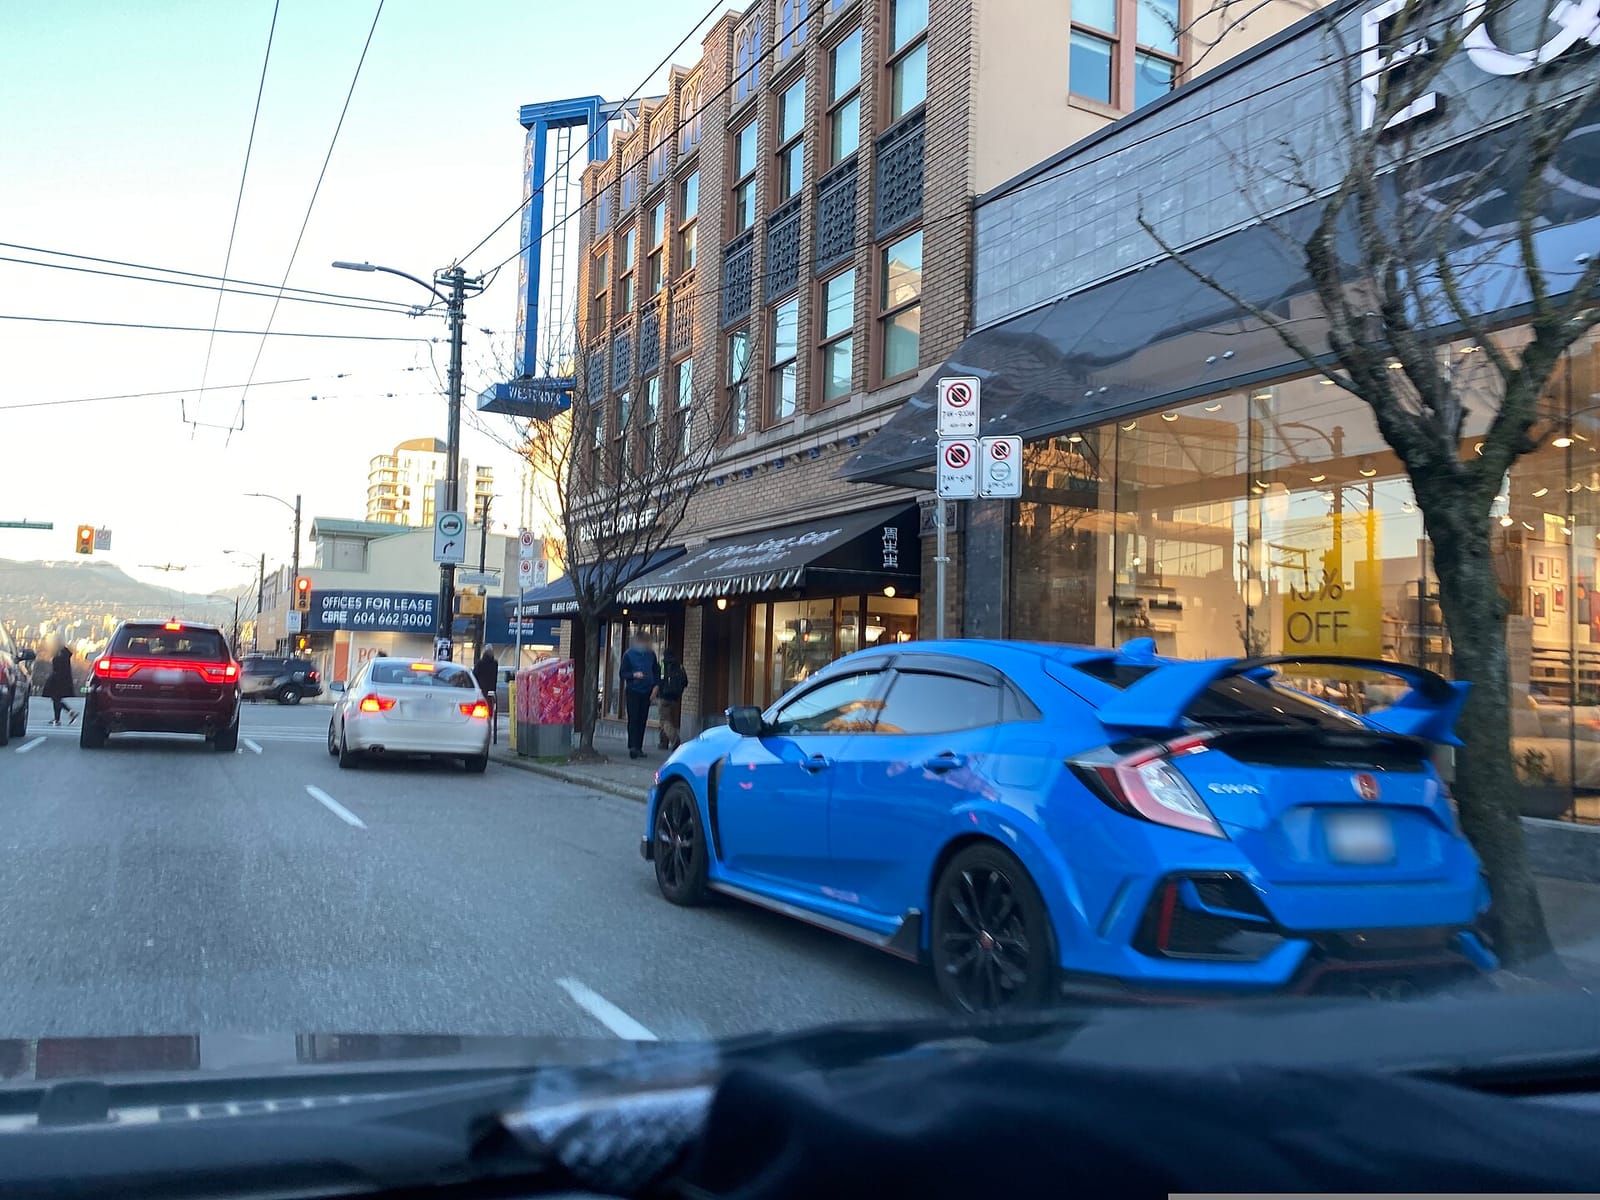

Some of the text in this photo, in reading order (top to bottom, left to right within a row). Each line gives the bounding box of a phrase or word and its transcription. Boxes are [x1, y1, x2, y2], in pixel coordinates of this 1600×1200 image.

[322, 596, 433, 612] OFFICES FOR LEASE
[354, 612, 375, 625] 604
[378, 612, 399, 626] 662
[402, 613, 432, 627] 3000
[1286, 610, 1350, 644] OFF
